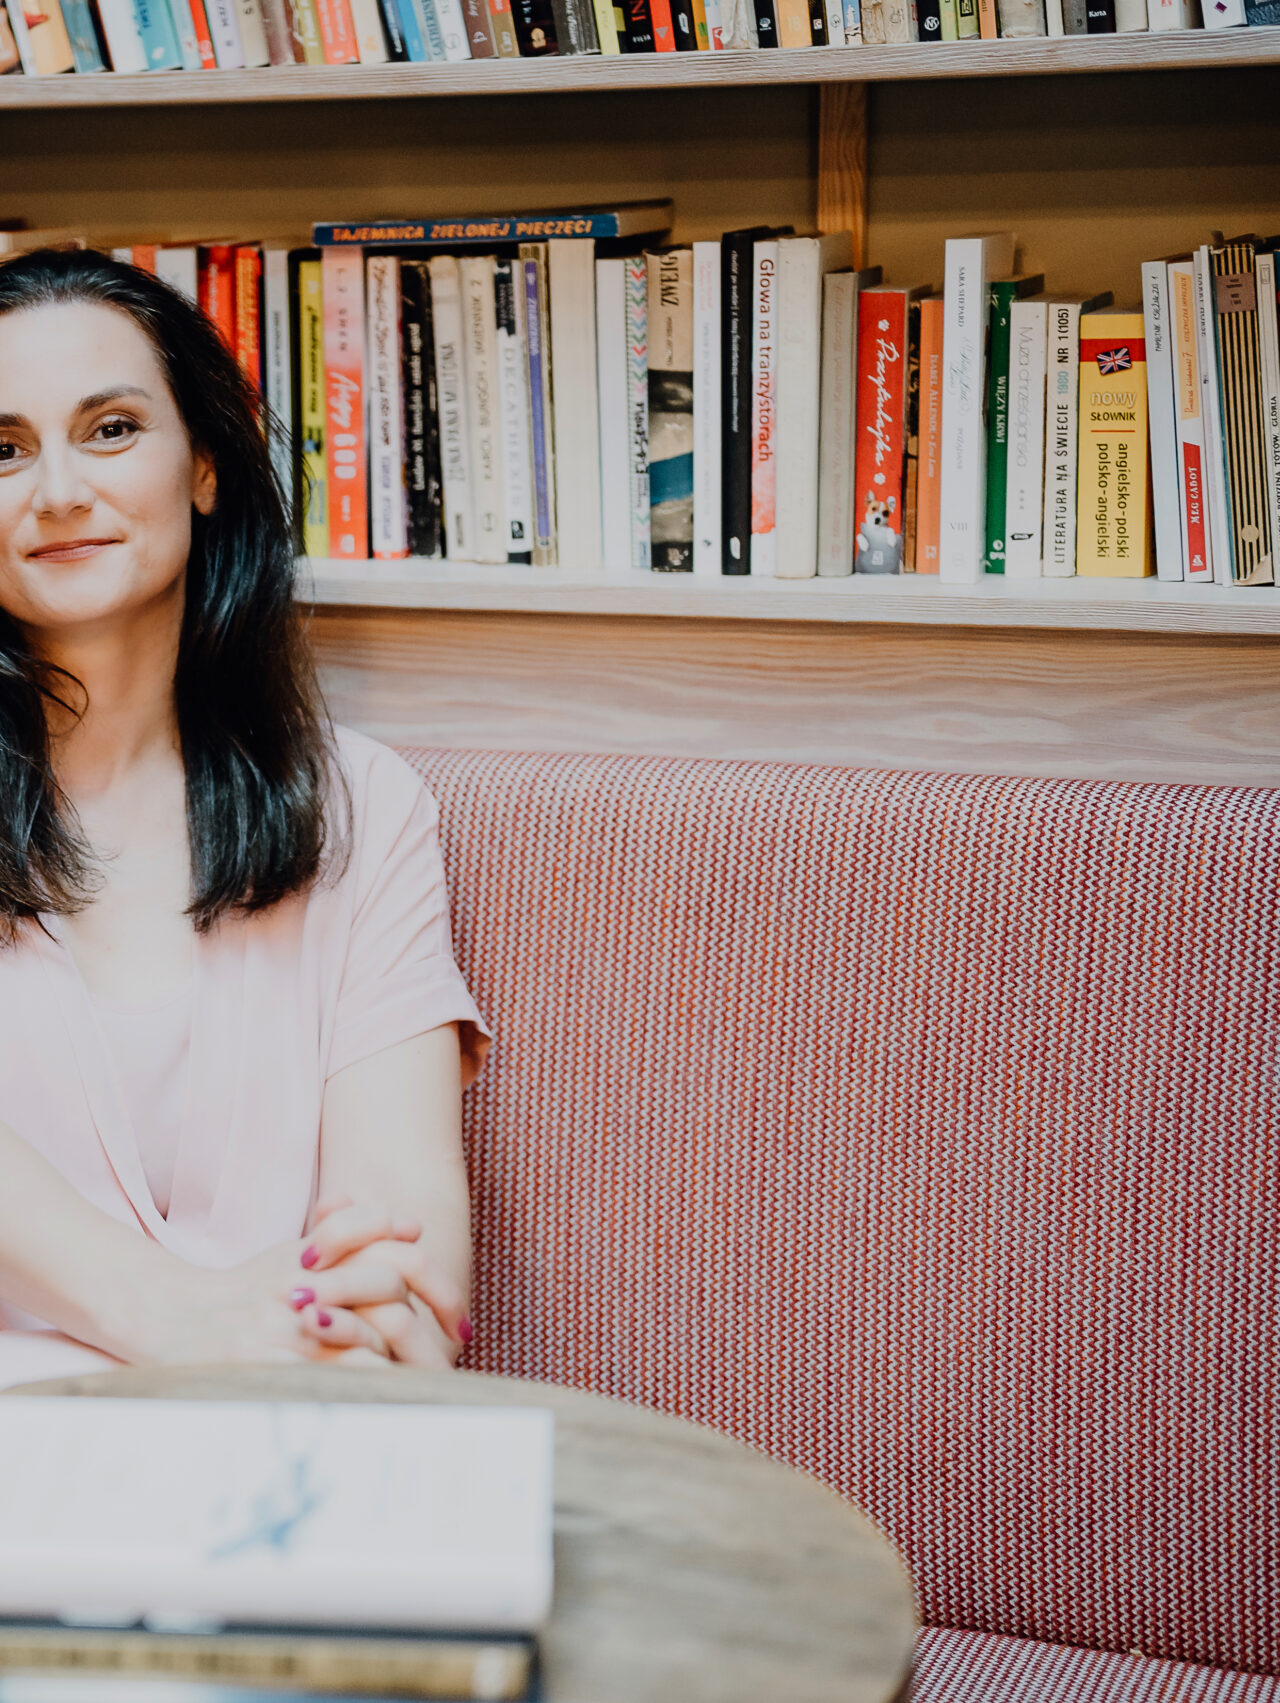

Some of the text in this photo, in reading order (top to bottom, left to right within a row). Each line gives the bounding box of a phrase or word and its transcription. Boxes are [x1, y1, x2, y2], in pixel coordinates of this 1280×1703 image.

[332, 218, 594, 243] TAJEMNICA ZIELONEJ PIECZĘCI
[659, 255, 680, 308] ZWEIG
[956, 265, 966, 328] SARA SHEPARD
[756, 259, 776, 462] Głowa na tranzystorach
[928, 353, 939, 387] ISABEL
[1018, 326, 1034, 366] Muza
[1057, 348, 1069, 364] NR
[329, 370, 361, 429] Angry
[865, 337, 901, 468] Przytulajka
[928, 389, 939, 434] ALLENDE
[995, 375, 1007, 443] WIĘZY KRWI
[1090, 391, 1137, 407] nowy
[1090, 411, 1136, 422] SŁOWNIK
[1269, 395, 1279, 427] GLORIA
[1053, 404, 1069, 457] ŚWIECIE
[1054, 465, 1069, 481] NA
[1187, 466, 1201, 525] MEG CABOT
[1054, 489, 1069, 564] LITERATURA
[1095, 443, 1112, 559] polsko-angielski
[1114, 443, 1132, 559] angielsko-polski
